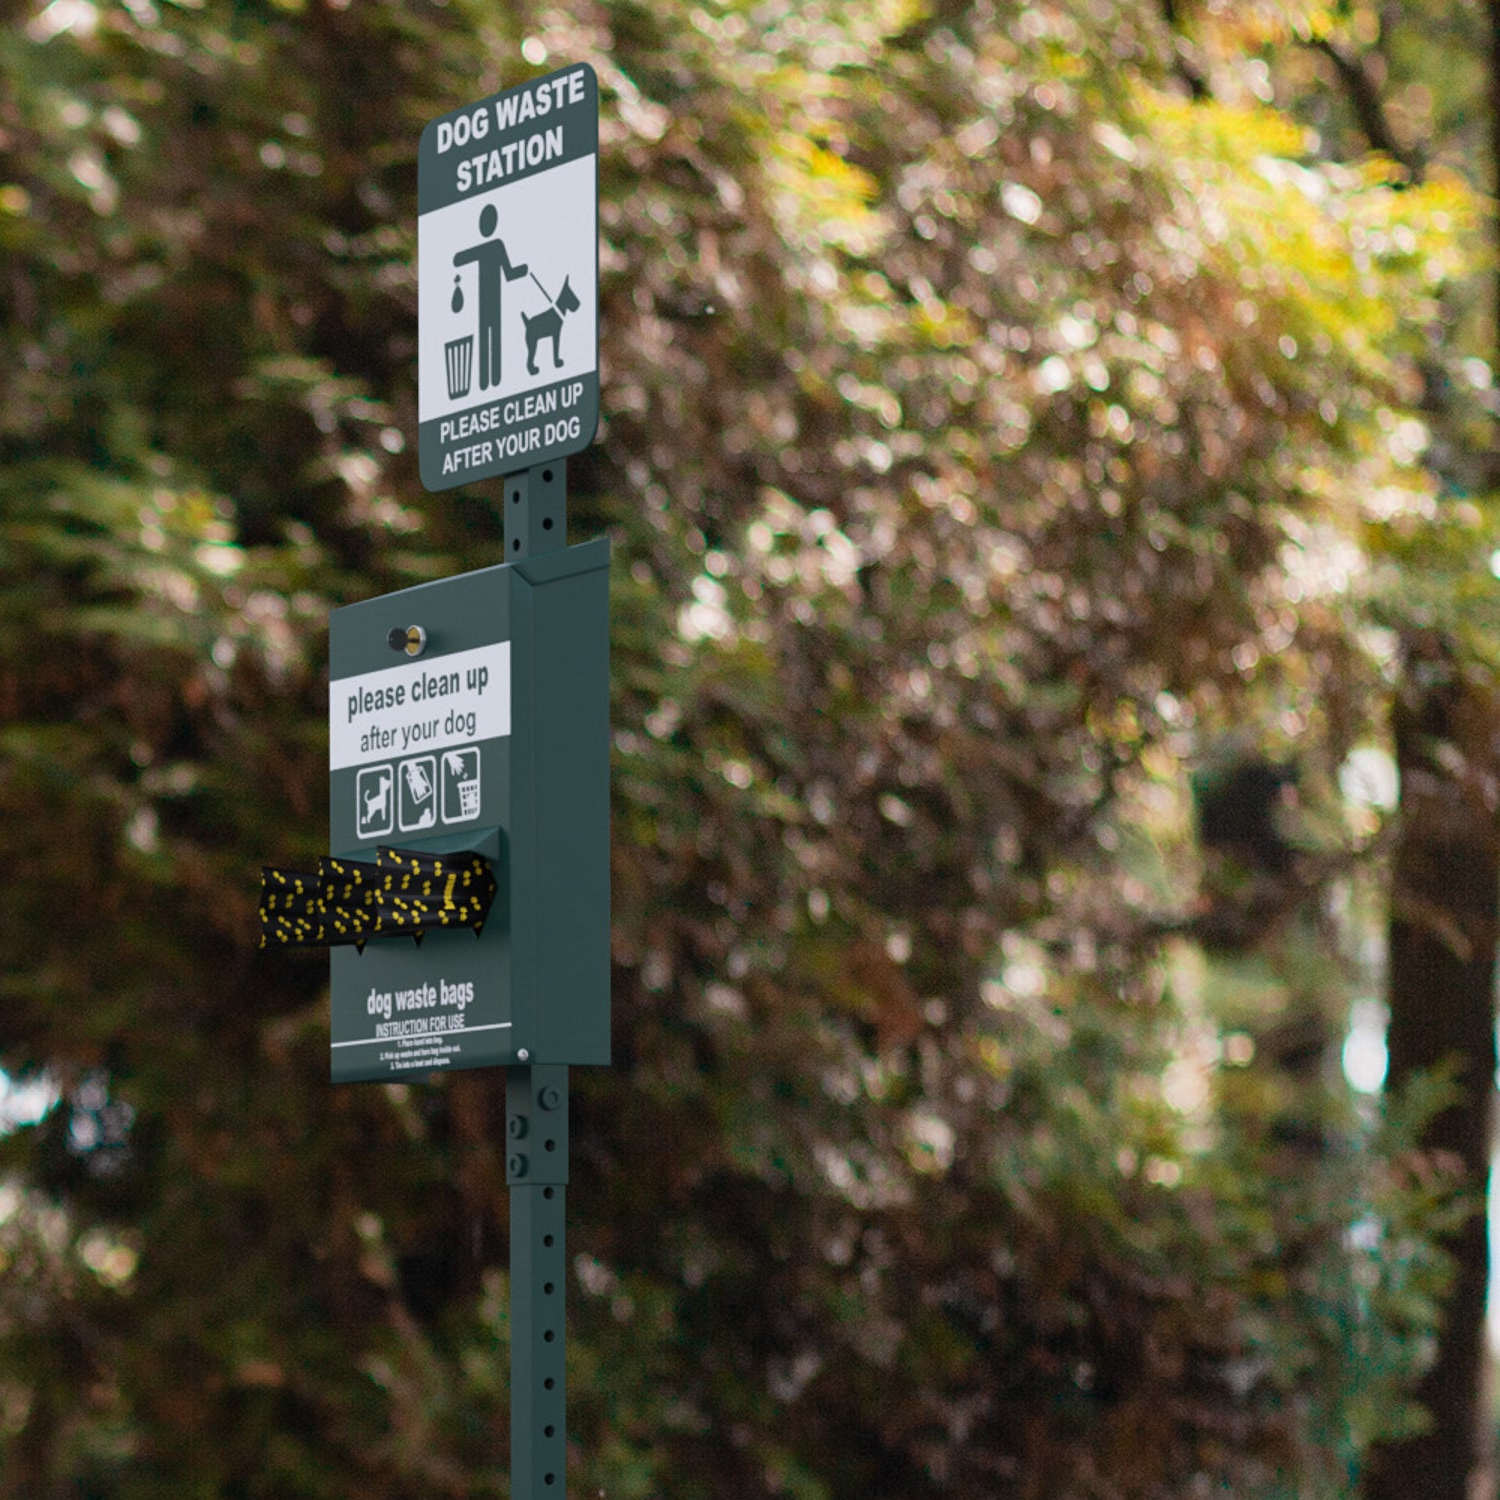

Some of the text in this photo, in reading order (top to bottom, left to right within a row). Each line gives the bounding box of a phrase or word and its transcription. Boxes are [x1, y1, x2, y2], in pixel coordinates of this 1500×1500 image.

[437, 69, 584, 154] DOG WASTE
[456, 125, 563, 192] STATION
[440, 382, 583, 444] PLEASE CLEAN UP
[442, 416, 580, 475] AFTER YOUR DOG
[348, 665, 488, 723] please clean up
[360, 709, 476, 752] after your dog
[367, 979, 474, 1019] dog waste bags
[375, 1013, 465, 1038] INSTRUCTION FOR USE
